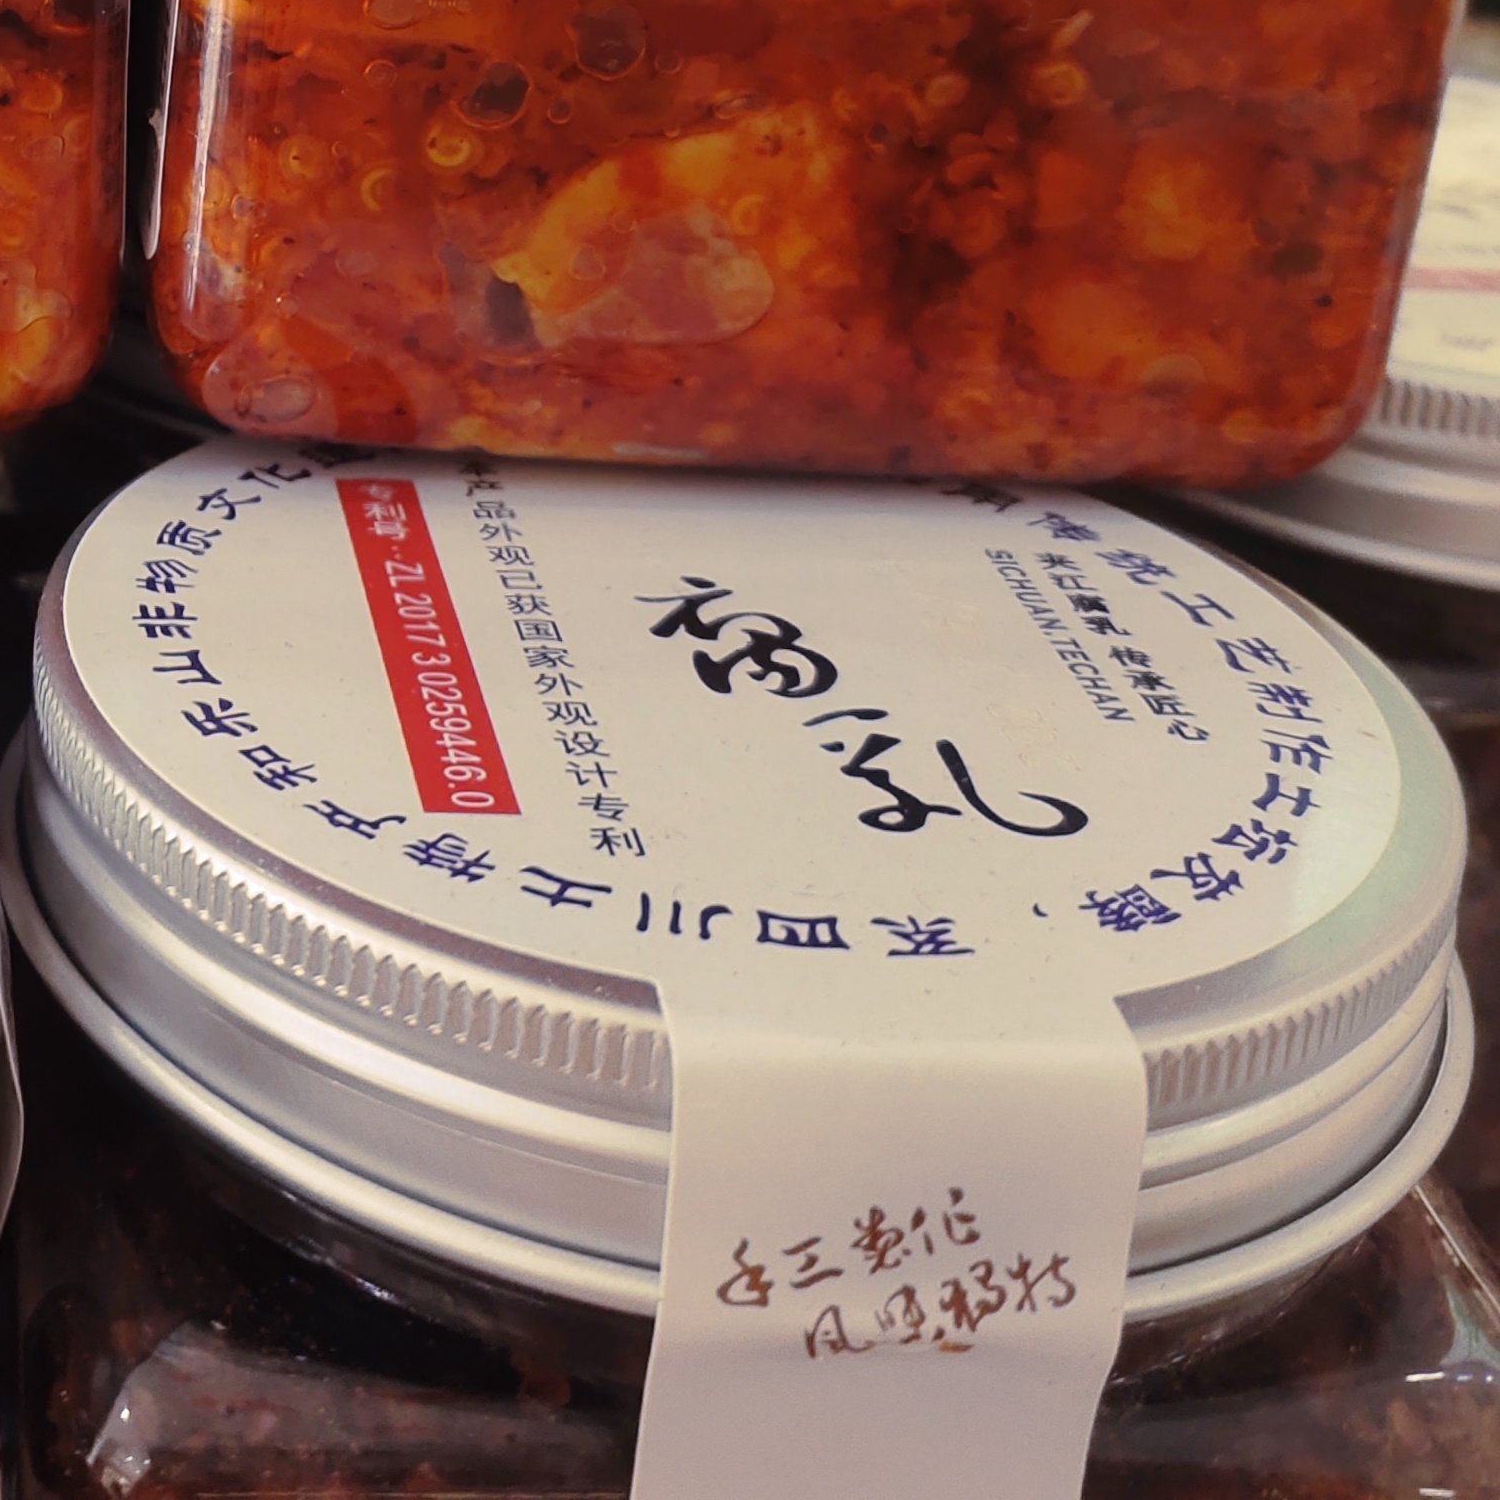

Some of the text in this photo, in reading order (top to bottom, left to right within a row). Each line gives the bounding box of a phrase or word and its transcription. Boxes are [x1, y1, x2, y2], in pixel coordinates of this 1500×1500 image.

[383, 560, 426, 588] ZL
[396, 590, 449, 648] 2017
[985, 549, 1136, 723] SICHUAN.TECHAN
[413, 651, 437, 673] 3
[1108, 645, 1210, 742] 传承匠心
[417, 673, 496, 810] 0259446.0
